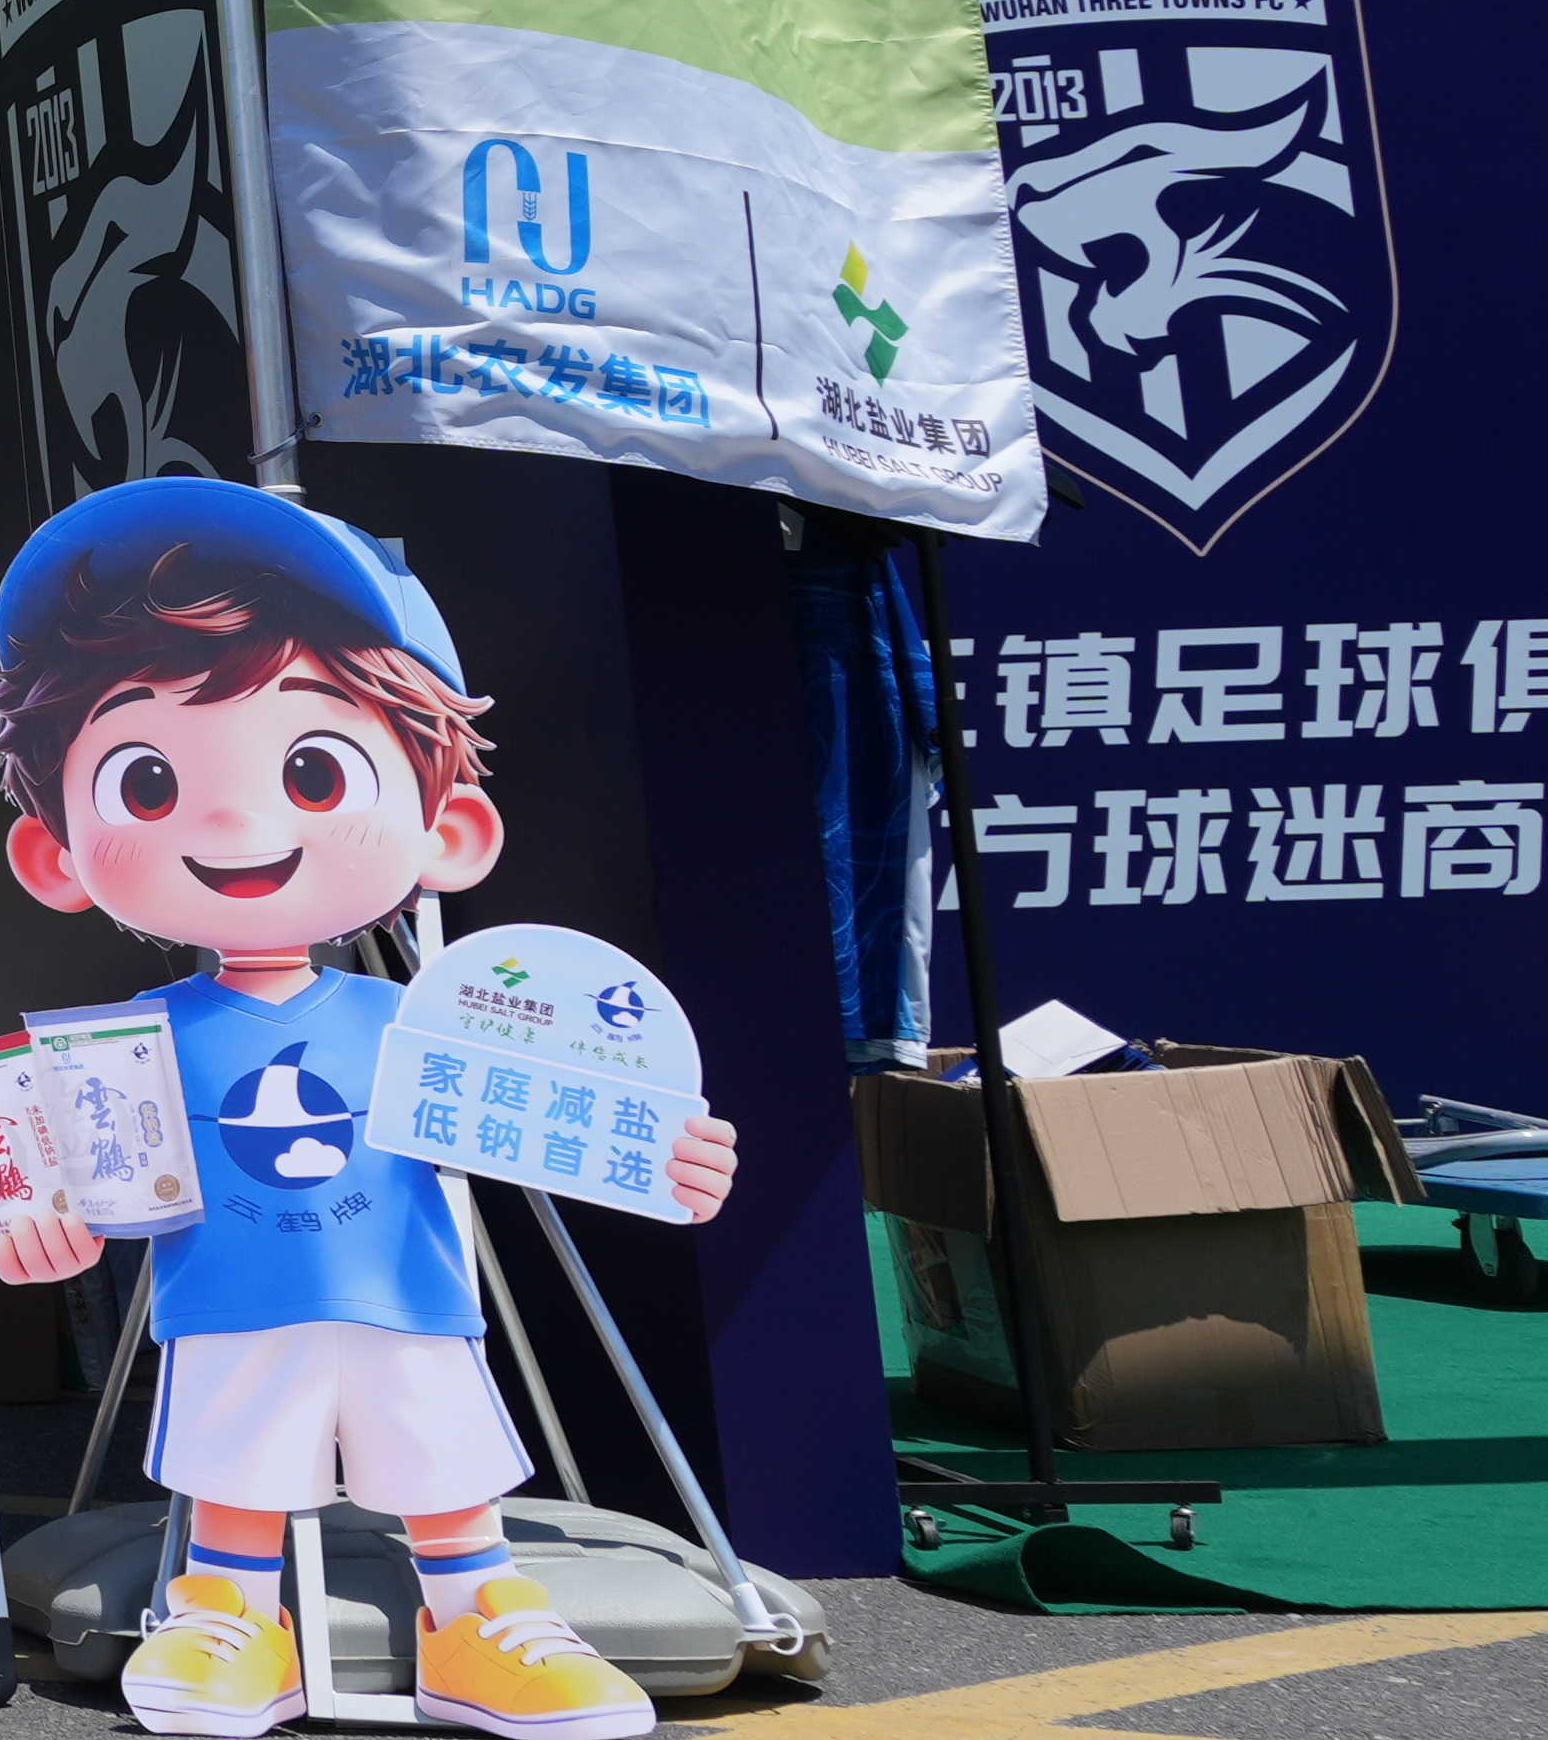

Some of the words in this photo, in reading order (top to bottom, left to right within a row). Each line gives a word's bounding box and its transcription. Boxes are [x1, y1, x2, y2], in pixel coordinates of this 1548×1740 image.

[991, 69, 1088, 123] 2013
[25, 87, 78, 197] 2013
[461, 275, 597, 321] HADG
[341, 333, 711, 430] 湖北农发集团
[815, 375, 993, 459] 湖北盐业集团
[822, 434, 877, 474] HUBEI
[877, 446, 933, 484] SALT
[932, 456, 1004, 494] GROUP
[458, 982, 555, 1018] 湖北盐业集团
[458, 998, 488, 1012] HUBEI
[489, 1004, 515, 1019] SALT
[517, 1011, 555, 1027] GROUP
[418, 1051, 661, 1145] 家庭减盐
[412, 1098, 653, 1195] 低钠首选
[222, 1191, 373, 1232] 云鹤牌
